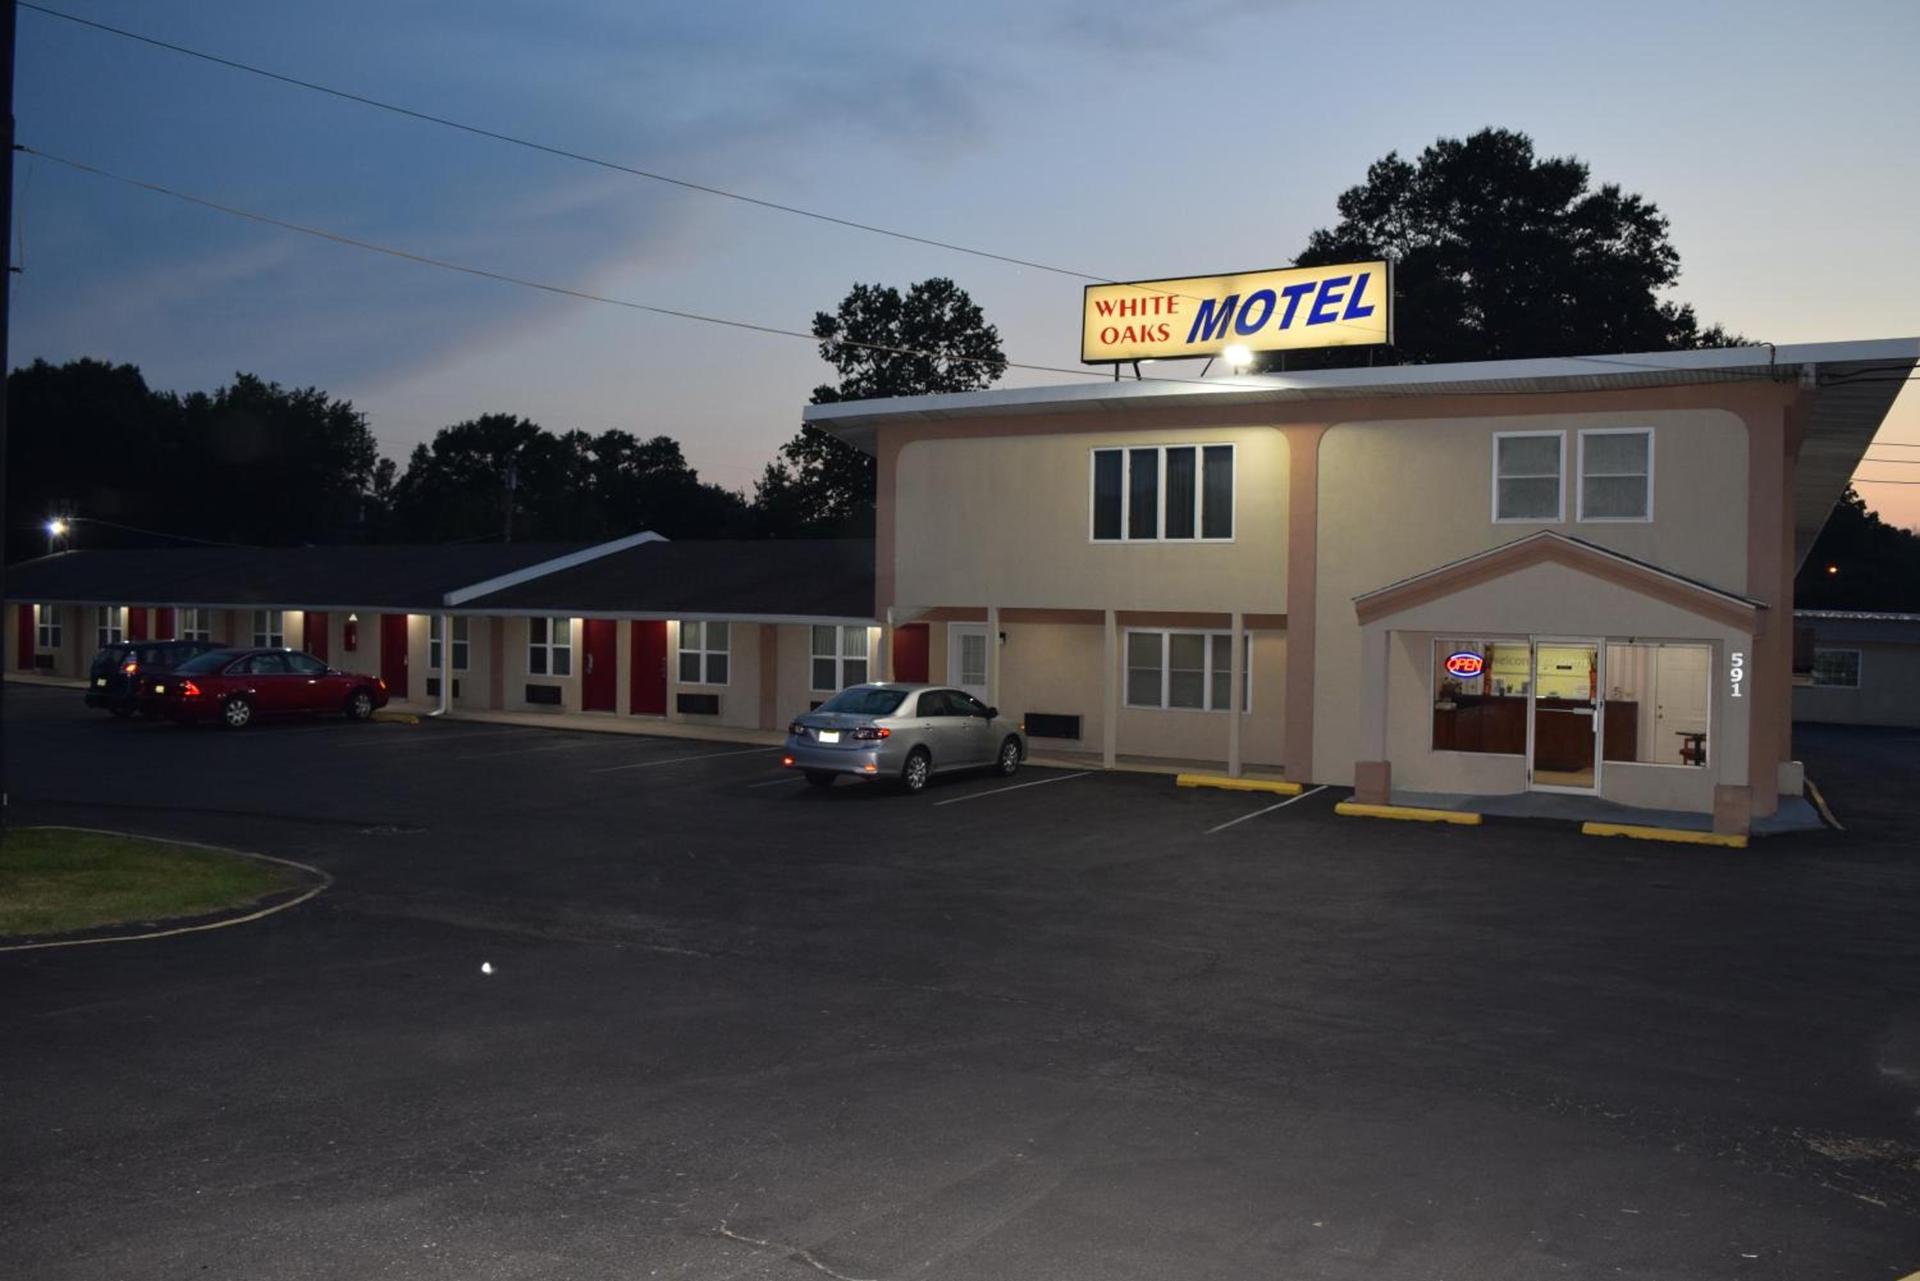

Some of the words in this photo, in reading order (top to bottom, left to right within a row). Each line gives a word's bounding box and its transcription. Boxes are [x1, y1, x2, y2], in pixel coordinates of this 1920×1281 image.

[1095, 294, 1179, 317] WHITE
[1186, 272, 1375, 344] MOTEL
[1100, 323, 1170, 345] OAKS
[1447, 658, 1483, 671] OPEN
[1730, 652, 1743, 697] 591
